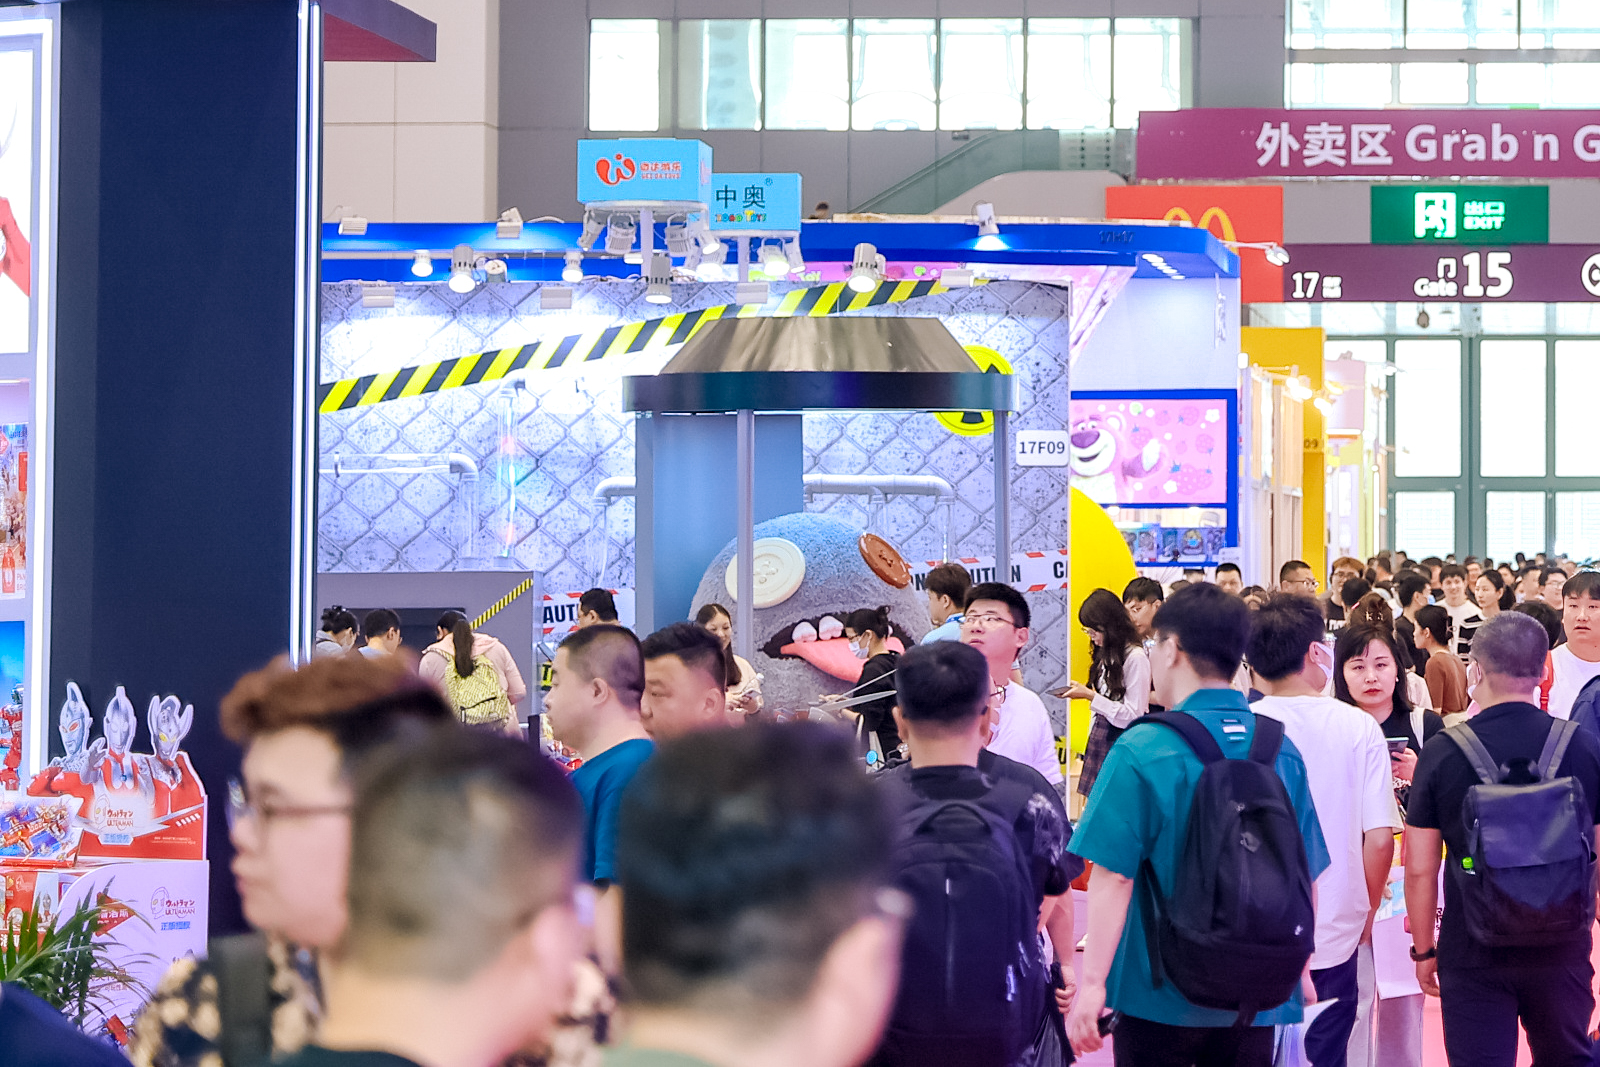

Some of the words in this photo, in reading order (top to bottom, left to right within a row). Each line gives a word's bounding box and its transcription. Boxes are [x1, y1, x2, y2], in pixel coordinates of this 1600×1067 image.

[1255, 121, 1394, 168] 外卖区
[1404, 122, 1519, 162] Grab
[1533, 133, 1559, 161] n
[715, 184, 766, 209] 中奥
[1463, 201, 1506, 217] 出口
[1463, 217, 1506, 231] EXIT
[1292, 272, 1320, 298] 17
[1462, 252, 1514, 298] 15
[1413, 278, 1459, 298] Gate
[1018, 440, 1066, 456] 17F09
